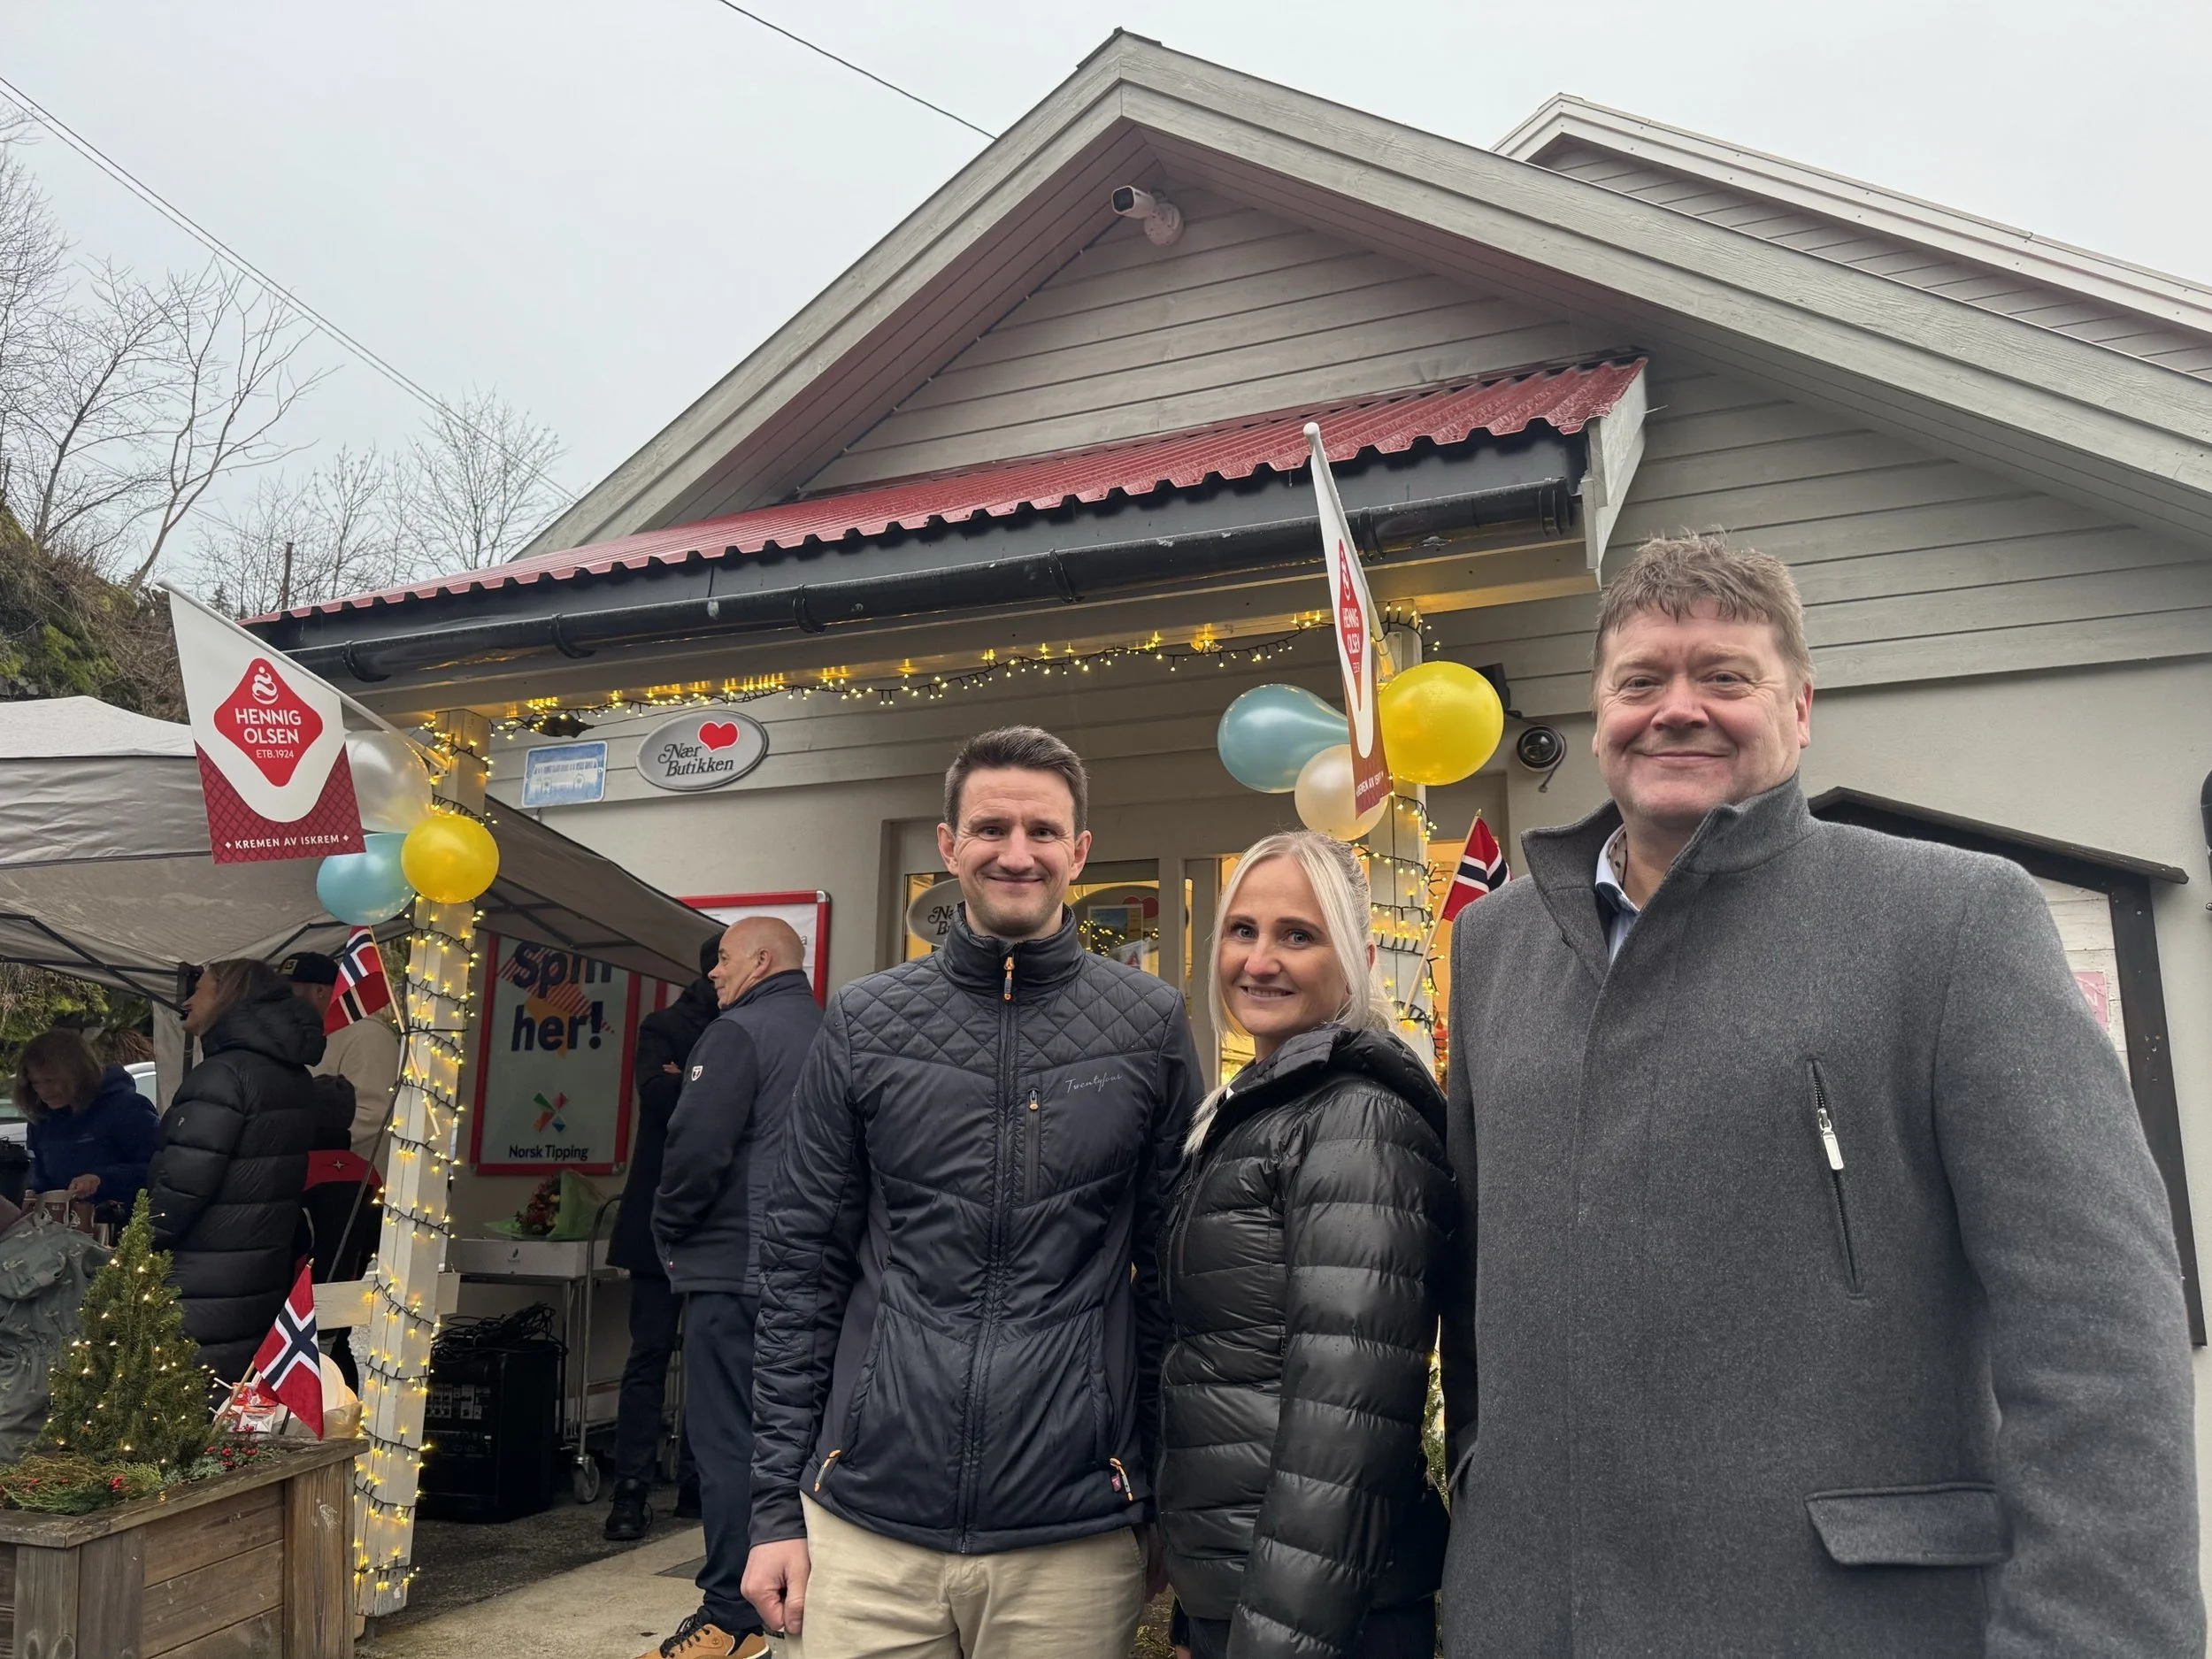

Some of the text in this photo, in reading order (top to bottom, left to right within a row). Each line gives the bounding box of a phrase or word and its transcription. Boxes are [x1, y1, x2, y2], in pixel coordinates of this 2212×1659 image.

[234, 708, 302, 726] HENNIG
[243, 727, 300, 744] OLSEN
[256, 749, 295, 759] ETB.1924
[657, 742, 703, 764] Nær
[665, 757, 733, 777] Butikken
[234, 834, 340, 849] KREMEN AV ISKREM
[511, 1001, 603, 1051] her!
[509, 1144, 588, 1162] Norsk Tipping
